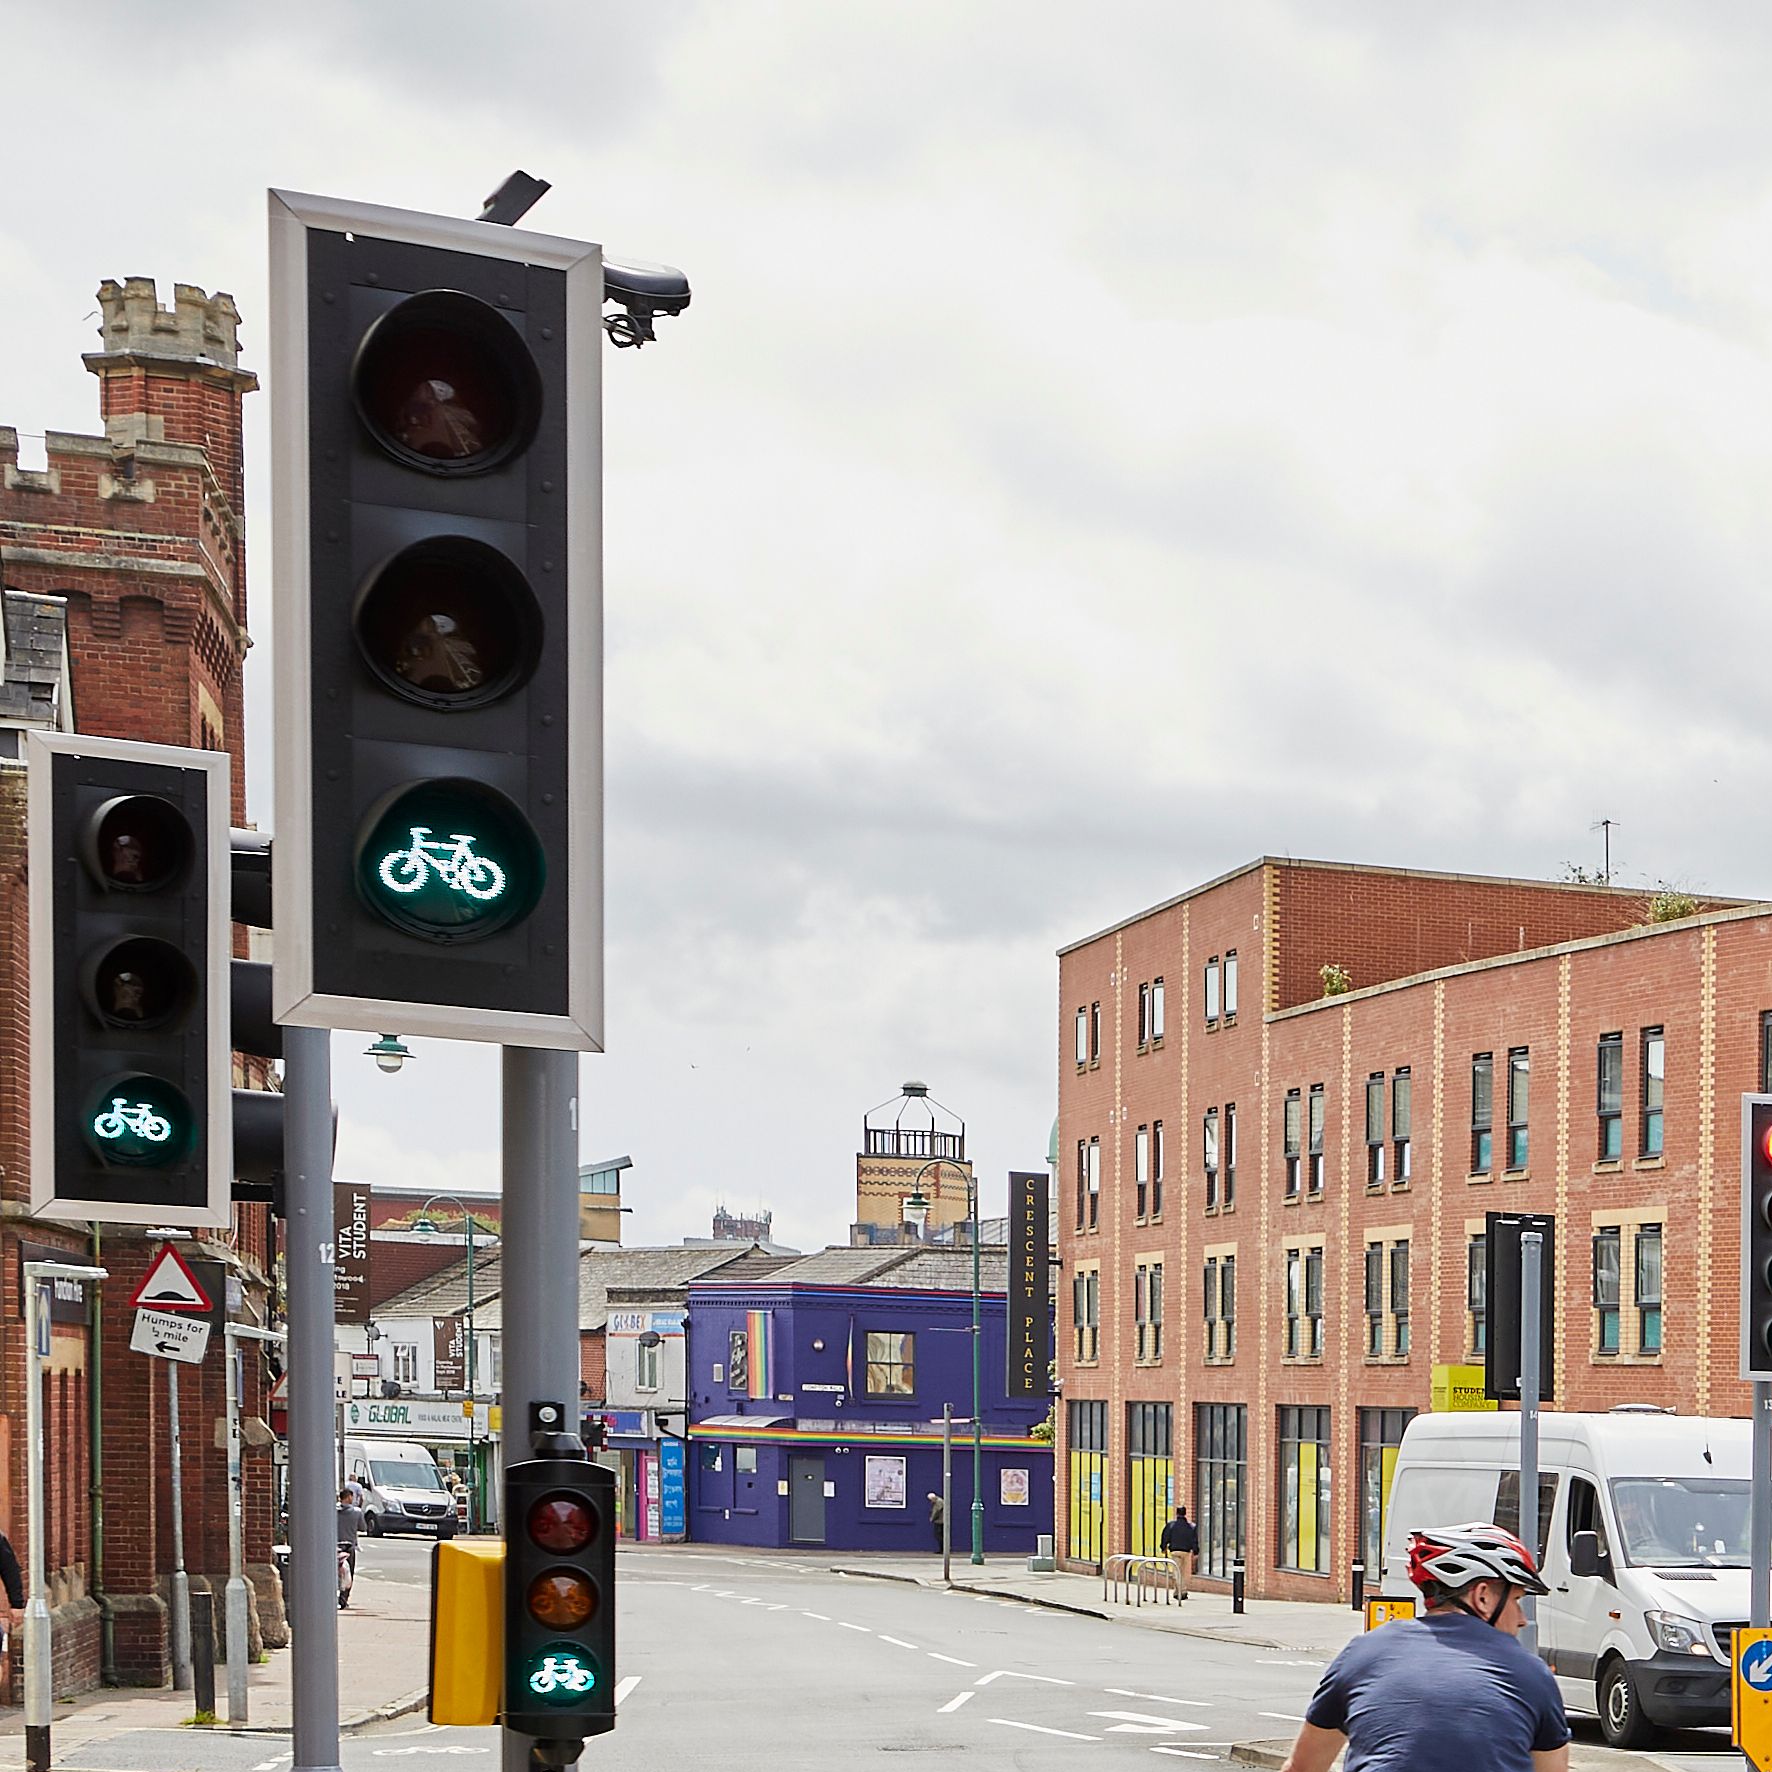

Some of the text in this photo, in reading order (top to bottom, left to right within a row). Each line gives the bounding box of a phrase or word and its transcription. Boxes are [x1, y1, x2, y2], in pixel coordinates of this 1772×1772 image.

[353, 1193, 367, 1259] STUDENT
[339, 1226, 352, 1258] VITA
[319, 1243, 335, 1264] 12
[1024, 1179, 1035, 1389] CRESCENT PLACE
[141, 1313, 203, 1334] Humps for
[164, 1331, 189, 1343] mile
[1453, 1393, 1484, 1401] HOUSIN
[368, 1405, 412, 1424] GLOBAL
